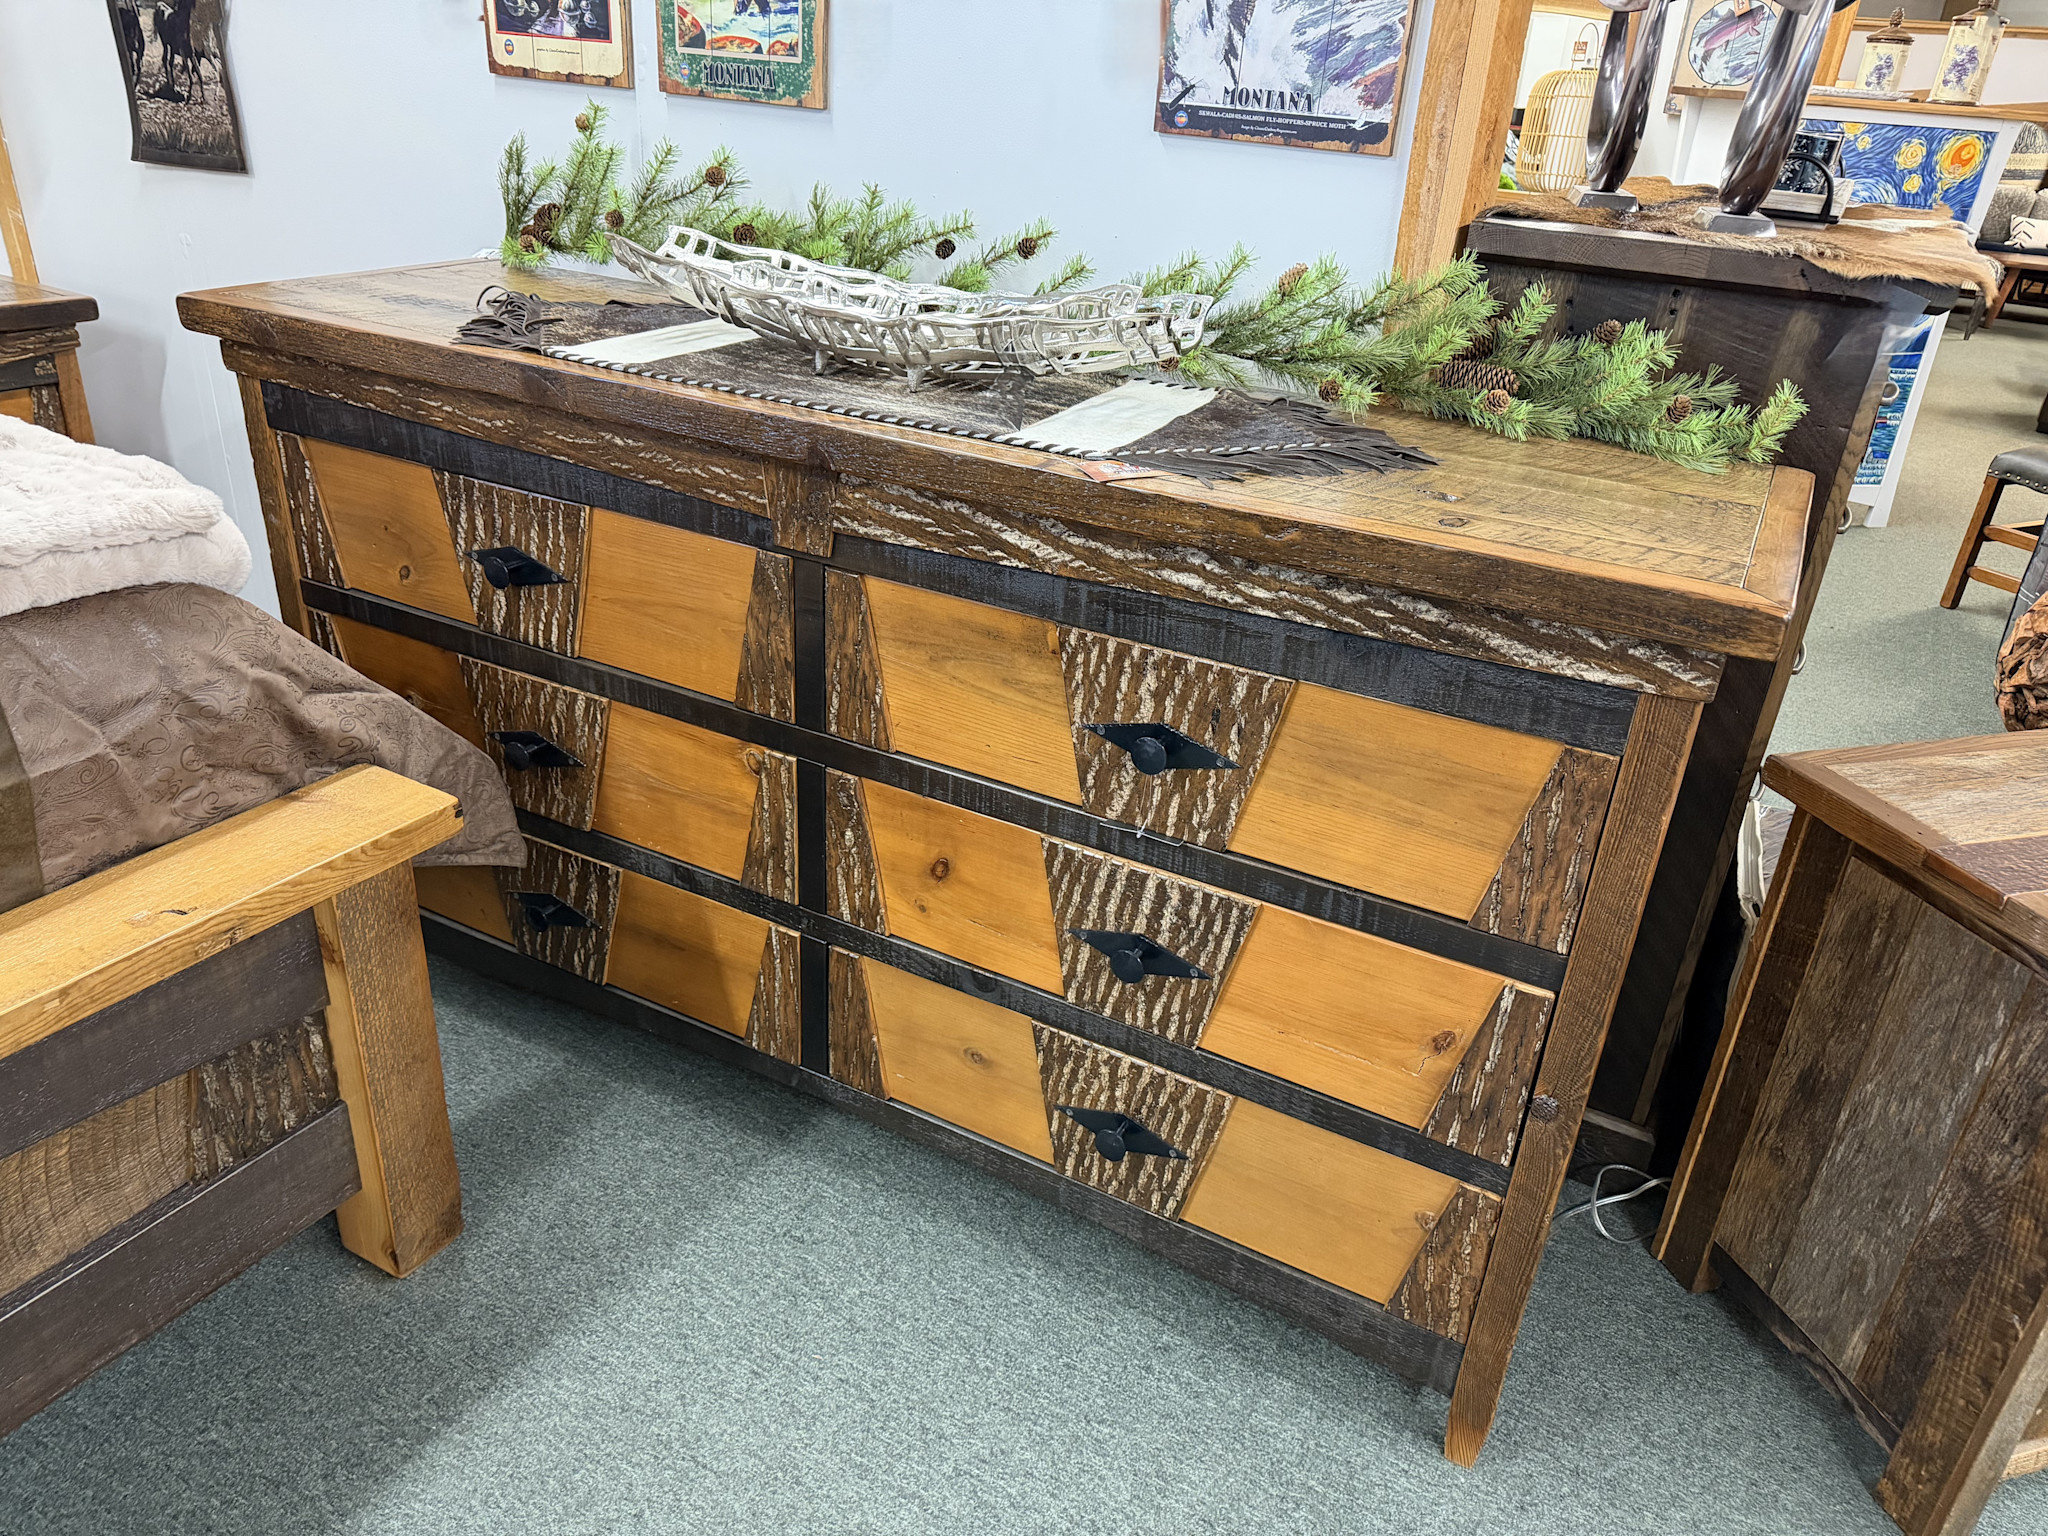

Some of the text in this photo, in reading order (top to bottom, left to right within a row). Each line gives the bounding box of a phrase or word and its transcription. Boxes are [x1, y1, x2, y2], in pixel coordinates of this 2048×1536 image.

[702, 61, 776, 91] MONTANA
[1222, 86, 1314, 113] MONTANA
[1328, 122, 1347, 130] MOTH
